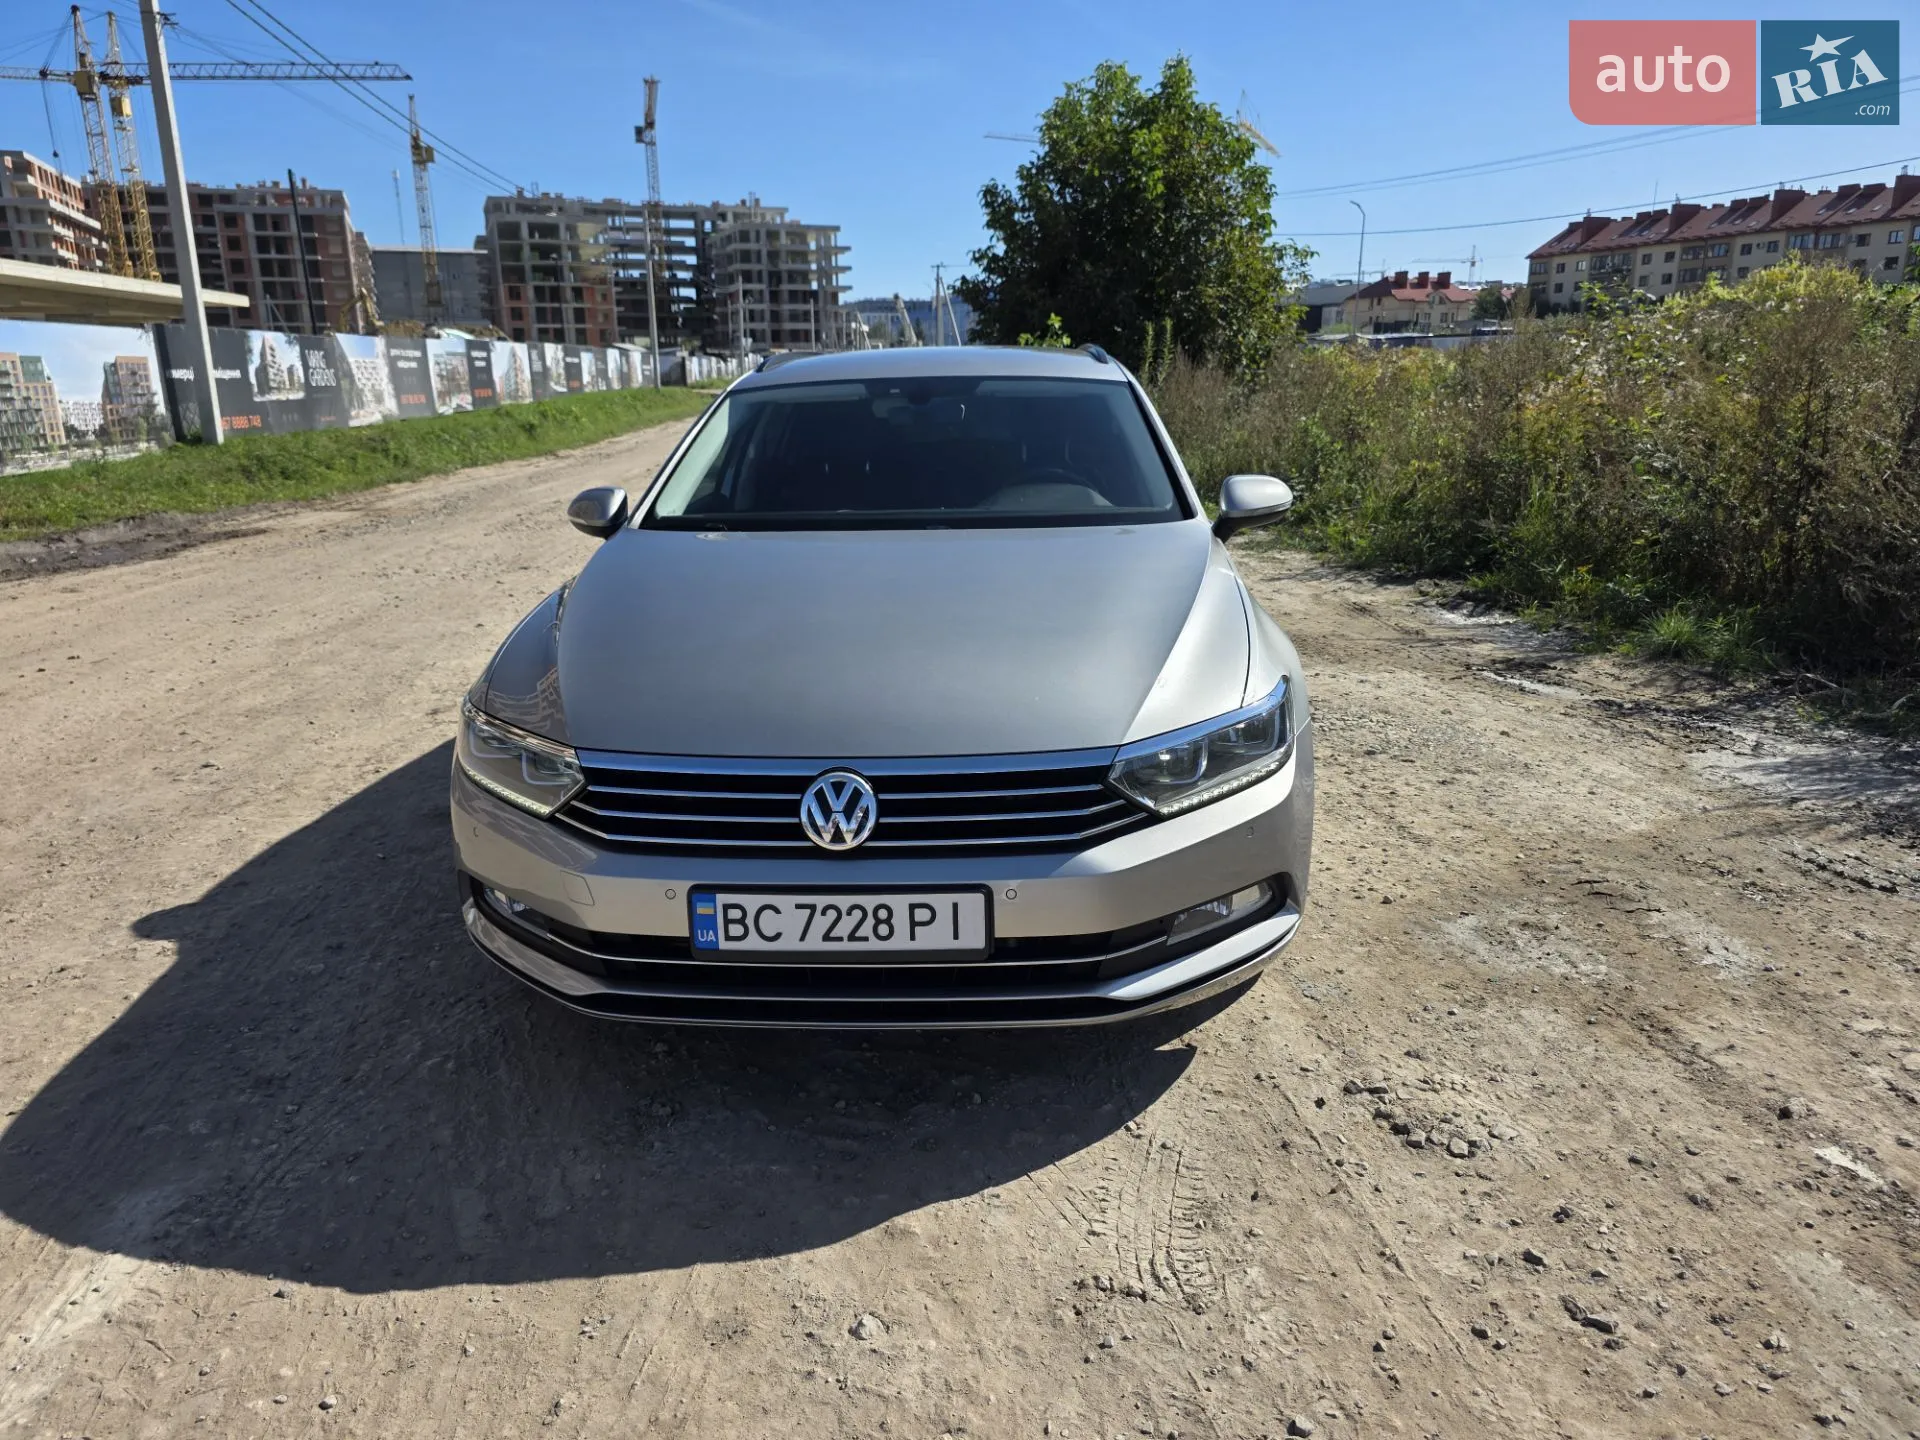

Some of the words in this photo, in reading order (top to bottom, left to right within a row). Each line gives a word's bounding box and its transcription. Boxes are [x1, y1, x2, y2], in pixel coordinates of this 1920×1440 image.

[697, 929, 717, 943] UA
[721, 902, 783, 943] BC
[793, 902, 895, 943] 7228
